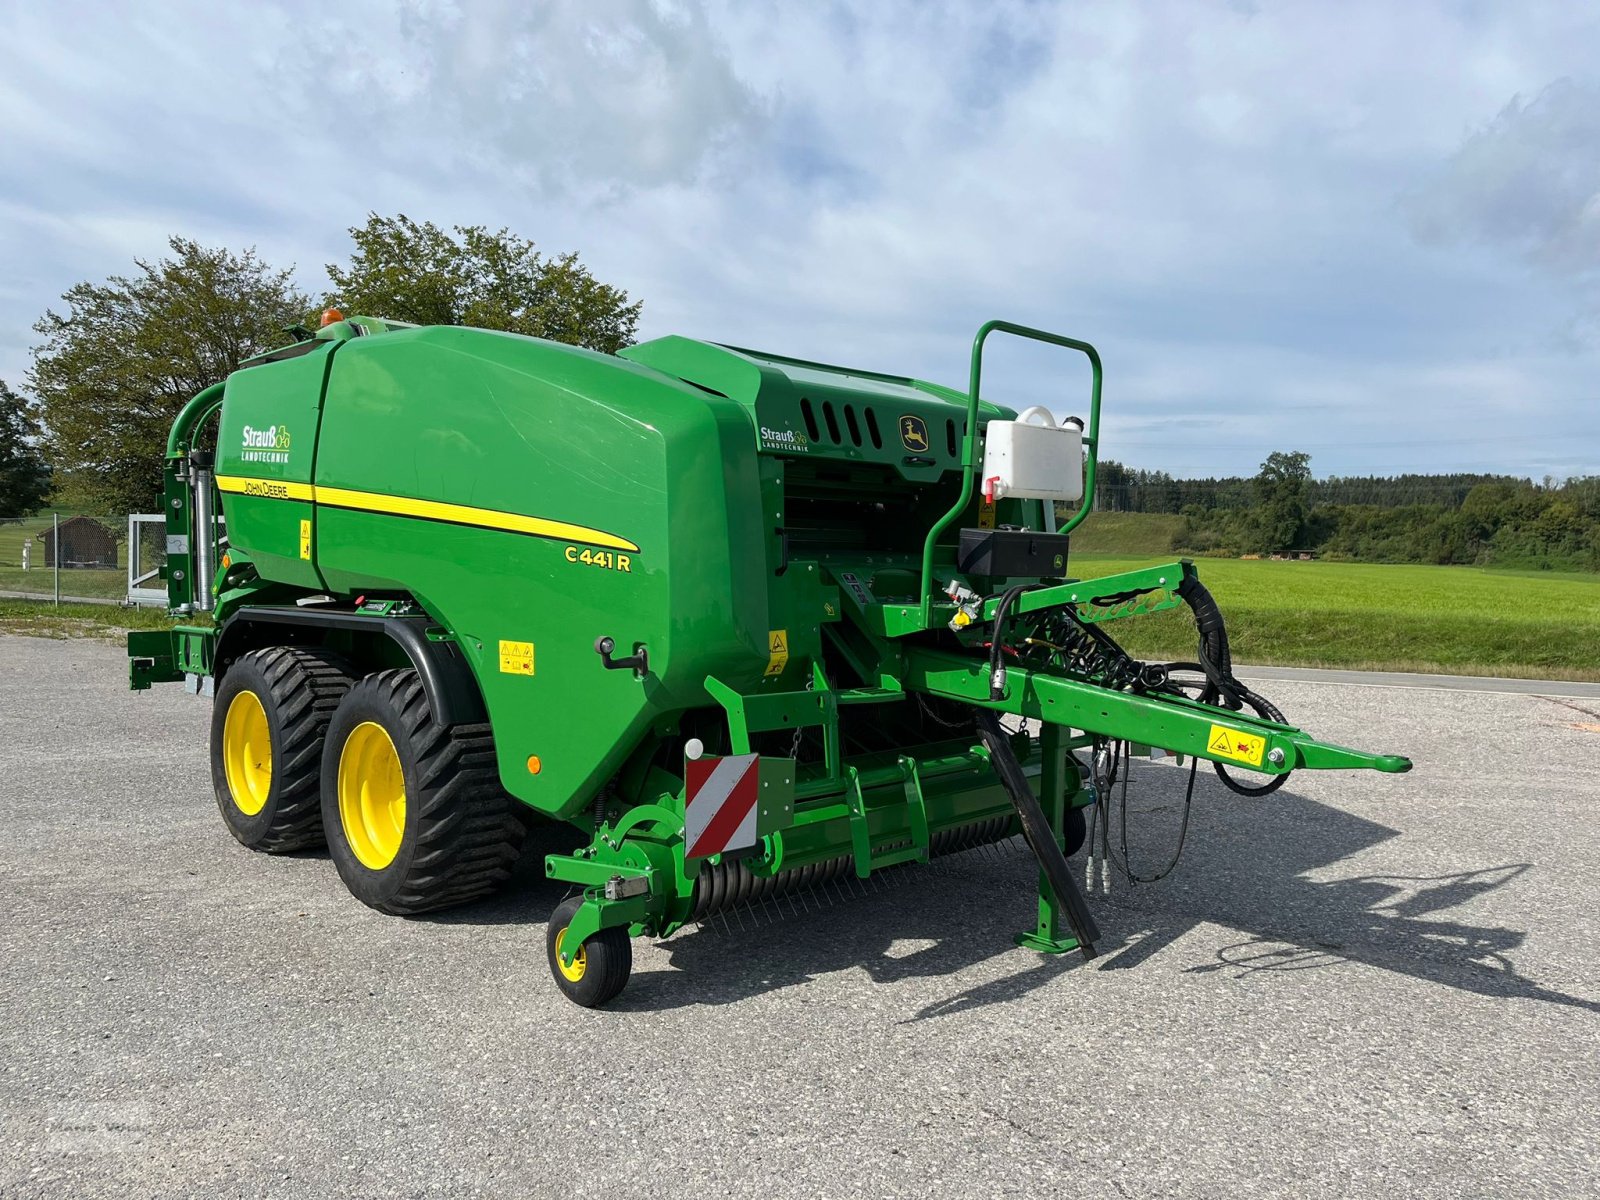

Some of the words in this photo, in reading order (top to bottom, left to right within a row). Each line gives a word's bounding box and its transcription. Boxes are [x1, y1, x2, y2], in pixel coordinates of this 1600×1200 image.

[242, 425, 276, 447] Strauß
[761, 427, 794, 442] Strauß
[763, 441, 808, 452] LANDTECHNIK
[241, 451, 289, 463] LANDTECHNIK
[564, 546, 577, 562] C
[579, 549, 613, 569] 441
[617, 554, 631, 572] R
